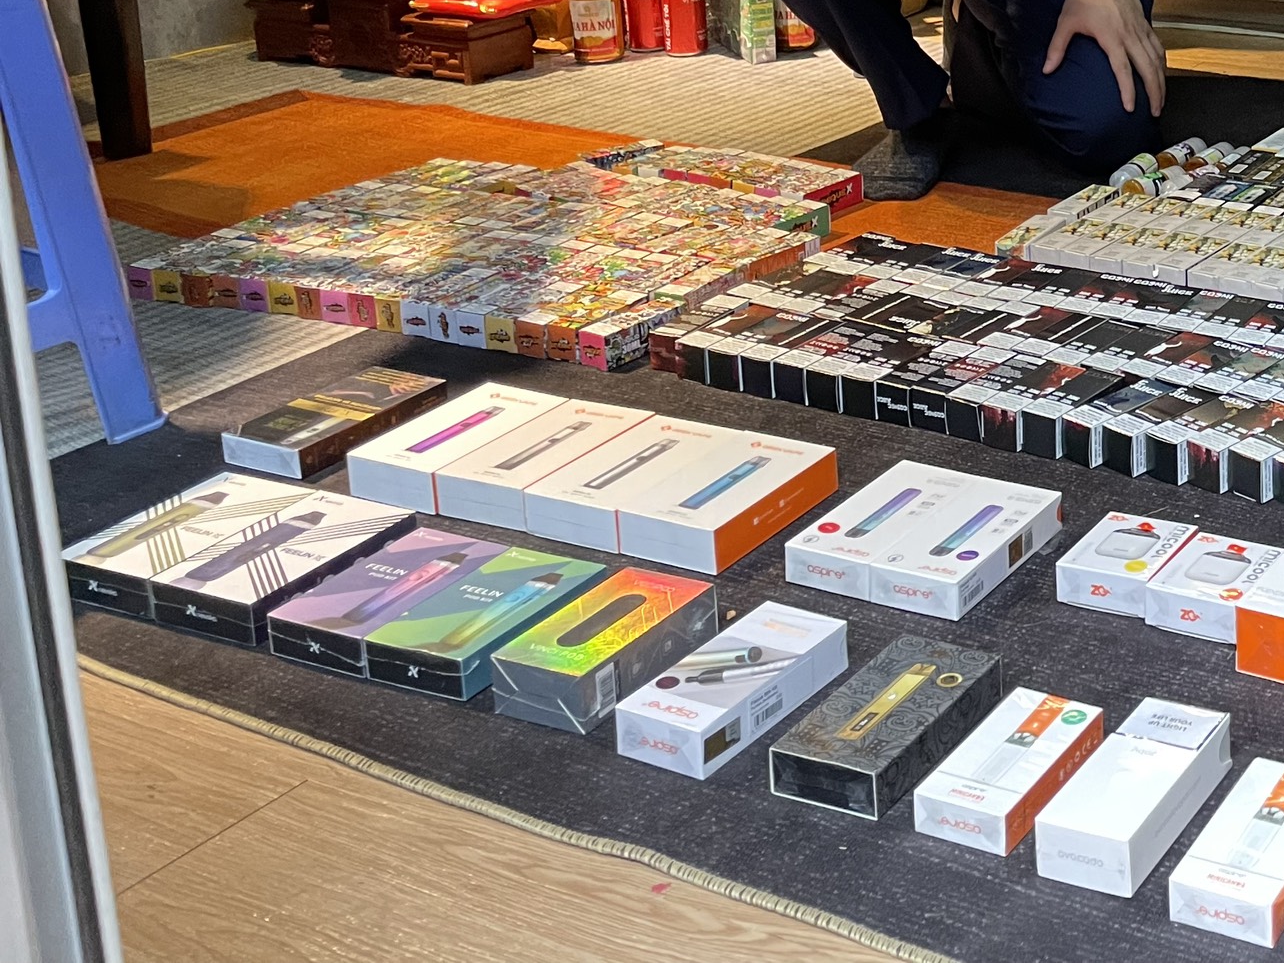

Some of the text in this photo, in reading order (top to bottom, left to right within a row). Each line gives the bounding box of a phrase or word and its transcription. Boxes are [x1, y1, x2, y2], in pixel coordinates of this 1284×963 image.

[366, 562, 409, 577] FEELIN
[807, 564, 846, 580] aspire
[459, 584, 504, 598] FEELIN
[893, 584, 934, 599] aspire
[530, 643, 585, 661] VINCI POD
[647, 700, 699, 719] aspire
[1164, 724, 1188, 732] LIGHT
[1172, 717, 1193, 726] YOUR
[939, 816, 982, 834] aspire
[1058, 849, 1104, 868] avocado
[1198, 905, 1245, 925] aspire
